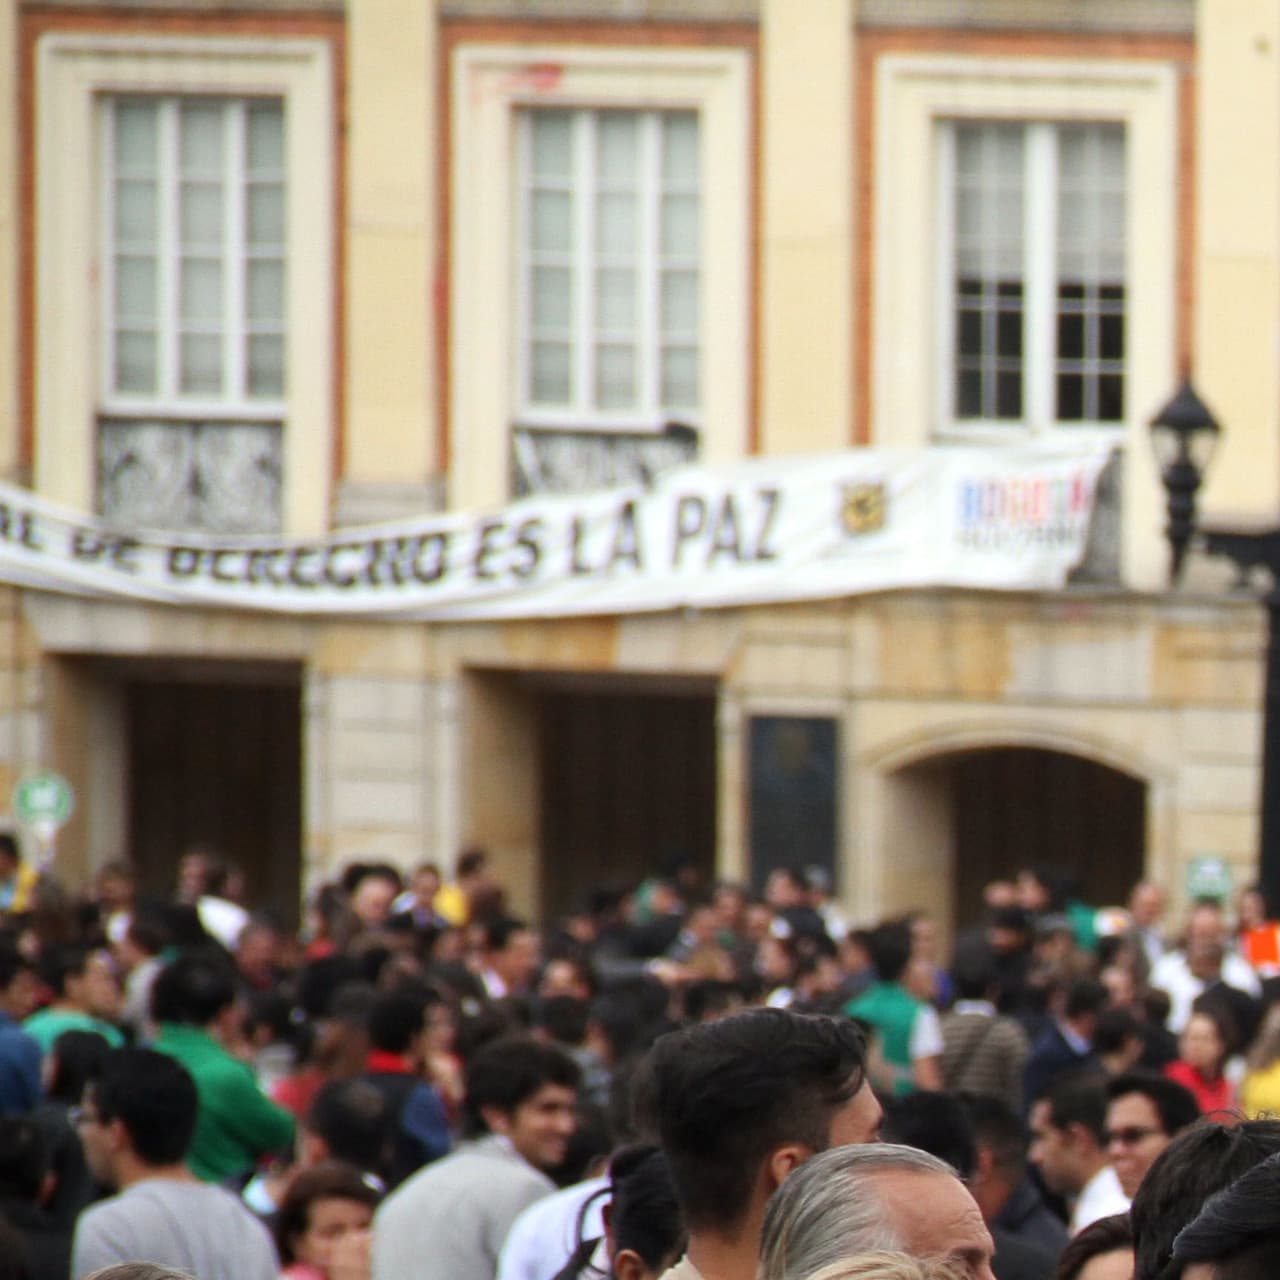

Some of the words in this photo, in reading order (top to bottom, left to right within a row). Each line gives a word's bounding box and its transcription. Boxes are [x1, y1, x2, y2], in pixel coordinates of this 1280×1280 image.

[170, 532, 447, 588] DERECHO
[474, 516, 542, 579] ES
[570, 498, 644, 575] LA
[672, 487, 782, 571] PAZ
